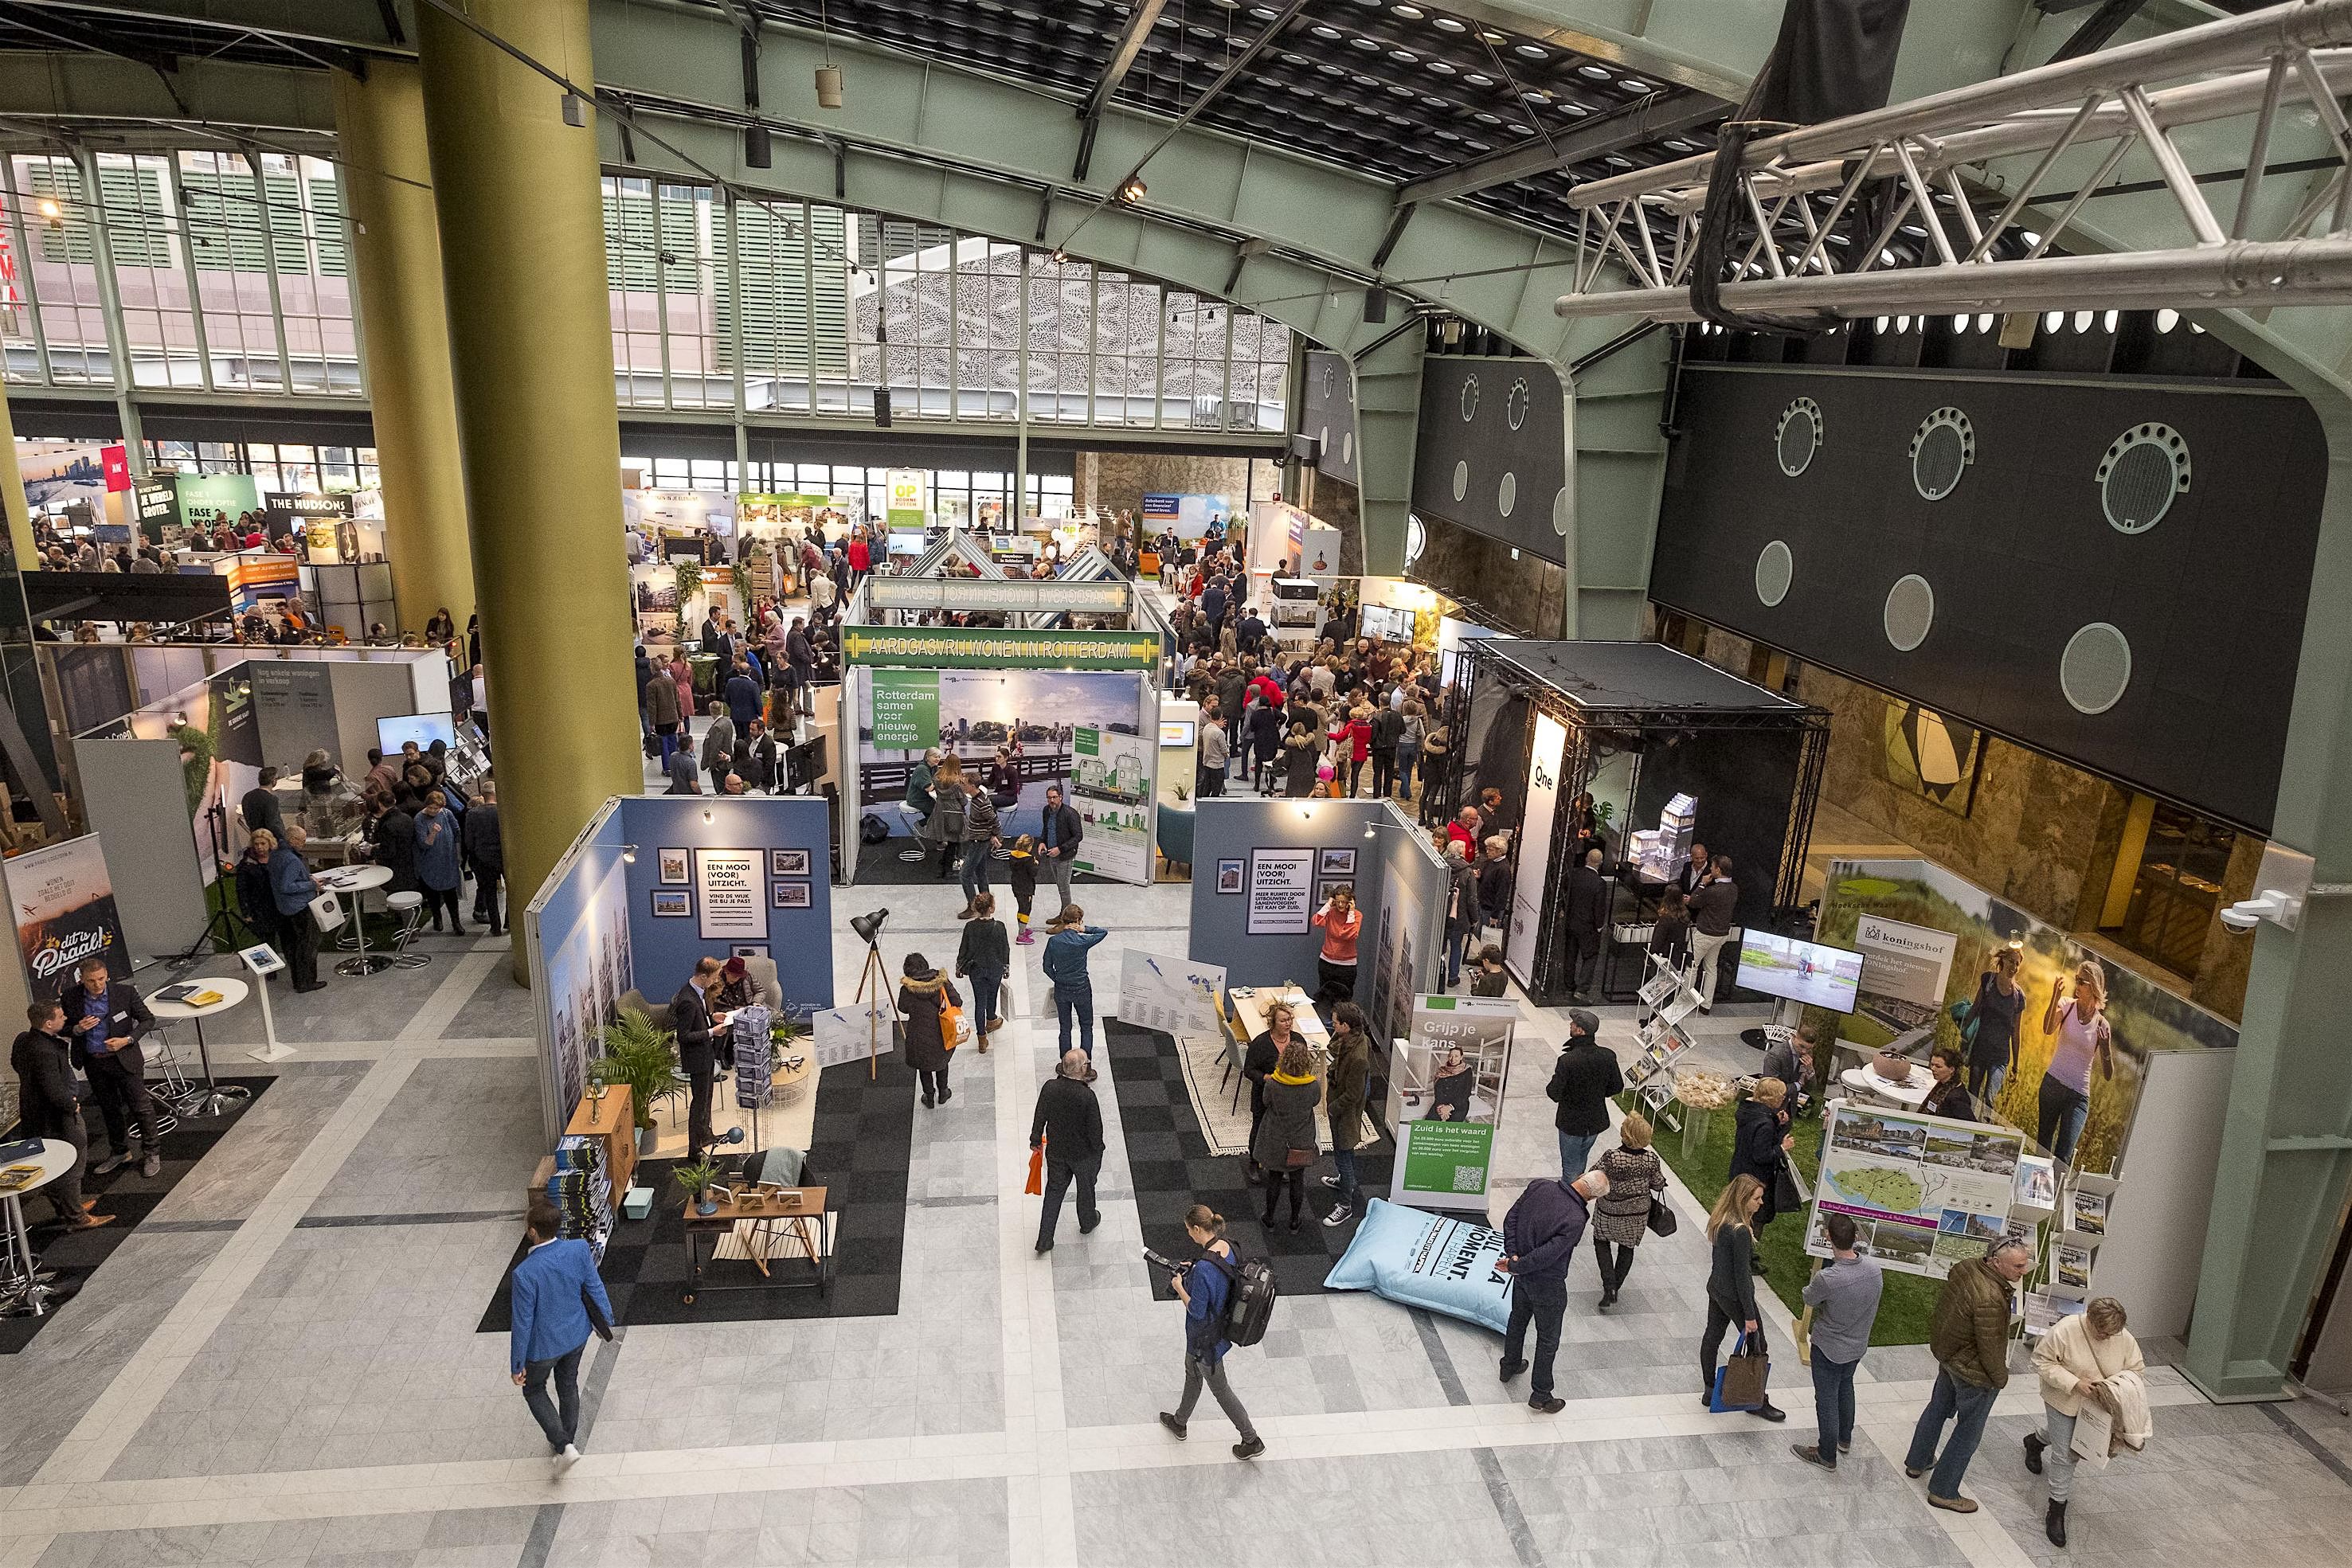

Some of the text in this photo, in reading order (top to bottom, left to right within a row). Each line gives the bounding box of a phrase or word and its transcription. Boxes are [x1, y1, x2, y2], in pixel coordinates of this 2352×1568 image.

[895, 485, 917, 497] OP
[140, 490, 174, 506] JE WERELD
[271, 499, 292, 510] THE
[295, 499, 346, 510] HUDSONS
[189, 508, 211, 517] FASE
[869, 637, 1131, 659] AARDGASVRIJ WONEN IN ROTTERDAM!
[876, 690, 935, 701] Rotterdam
[877, 721, 917, 731] nieuwe
[878, 733, 919, 744] energie
[1536, 766, 1552, 790] One
[61, 930, 91, 949] dit is
[1883, 933, 1945, 954] koningshof
[1891, 957, 1904, 966] het
[1904, 961, 1931, 973] nieuwe
[956, 1021, 969, 1034] OP
[1424, 1021, 1477, 1037] Grijp je
[1422, 1036, 1456, 1048] kans
